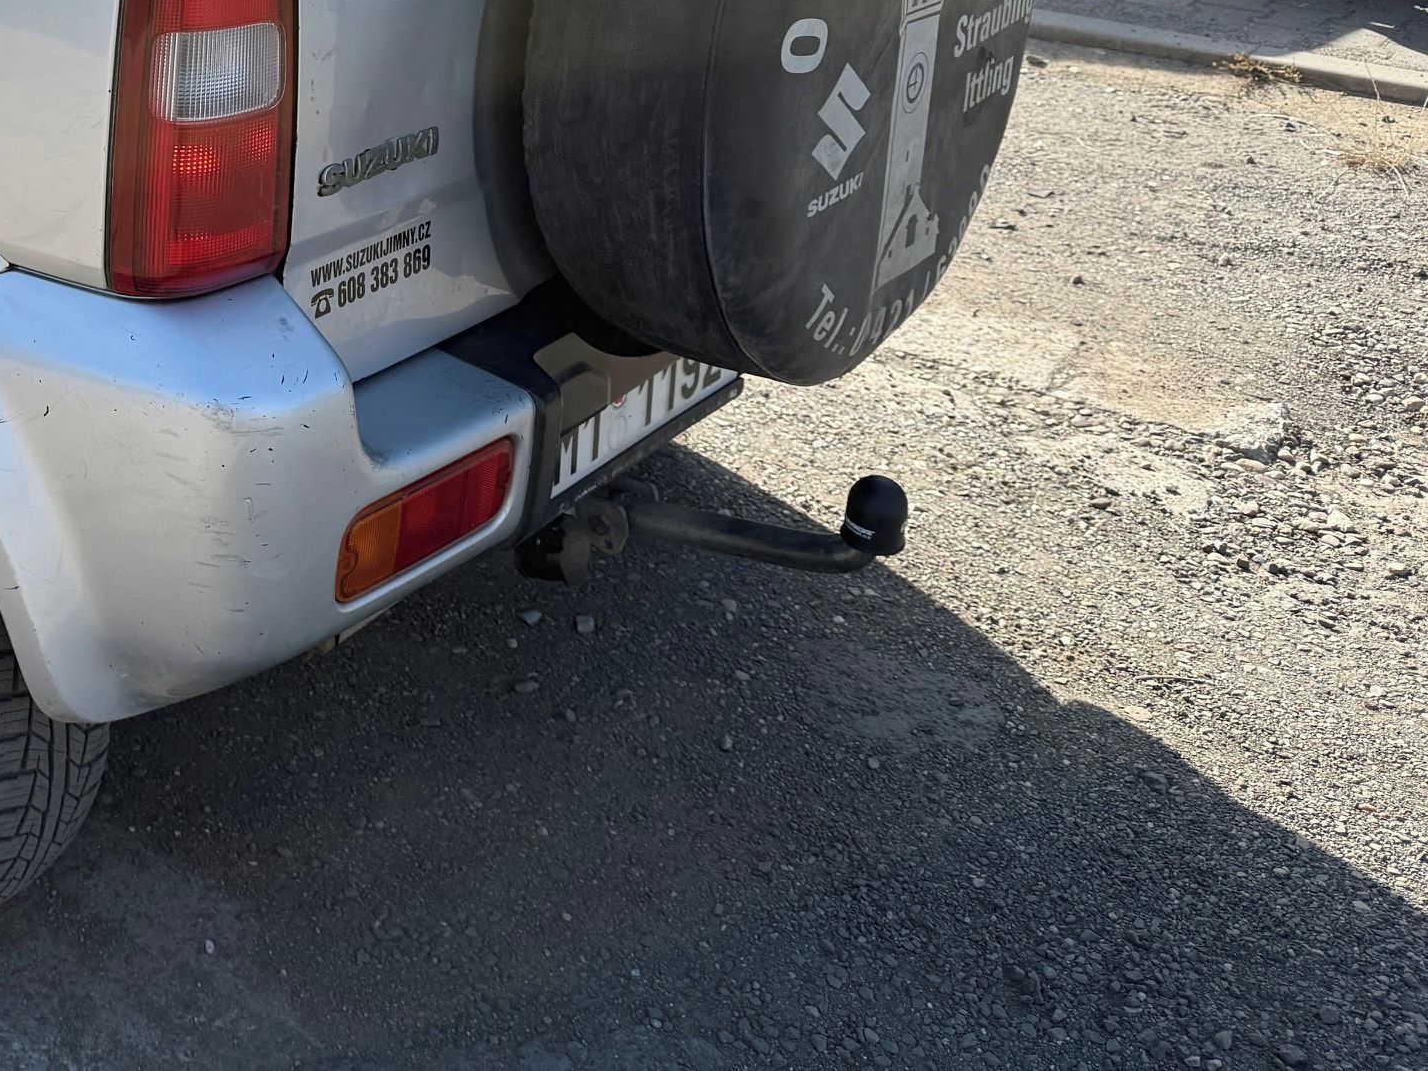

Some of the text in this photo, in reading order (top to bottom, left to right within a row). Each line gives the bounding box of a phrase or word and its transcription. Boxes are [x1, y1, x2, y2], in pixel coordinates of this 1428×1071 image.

[962, 55, 1015, 113] Ittling
[317, 126, 440, 197] SUZUKI
[807, 172, 865, 218] SUZUKI
[310, 220, 432, 288] WWW.SUZUKIJIMNY.CZ
[337, 244, 431, 308] 608 383 869
